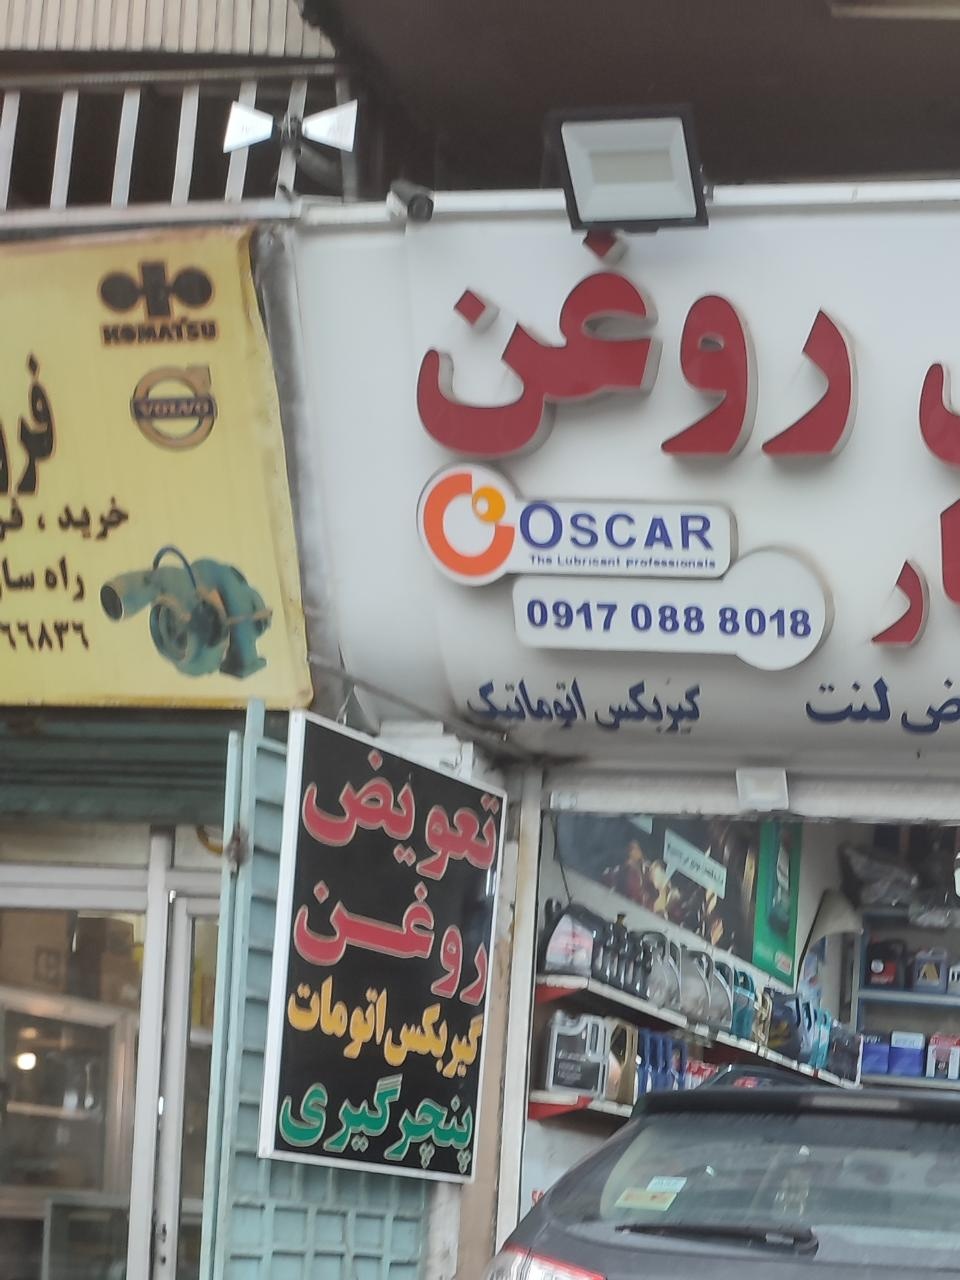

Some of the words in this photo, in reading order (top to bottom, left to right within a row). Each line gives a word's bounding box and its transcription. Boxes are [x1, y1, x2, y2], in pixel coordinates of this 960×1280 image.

[102, 319, 216, 345] KOMATSU
[416, 228, 853, 457] روغن
[57, 496, 129, 541] خرید
[519, 500, 714, 552] OSCAR
[45, 556, 85, 602] راه
[530, 554, 553, 566] The
[557, 555, 620, 567] Lubricant
[526, 598, 619, 633] 0917
[630, 602, 706, 635] 088
[718, 606, 813, 640] 8018
[805, 676, 892, 724] لنت
[302, 749, 499, 881] تعویض
[293, 880, 490, 1006] روغن
[287, 974, 388, 1060] اتومات
